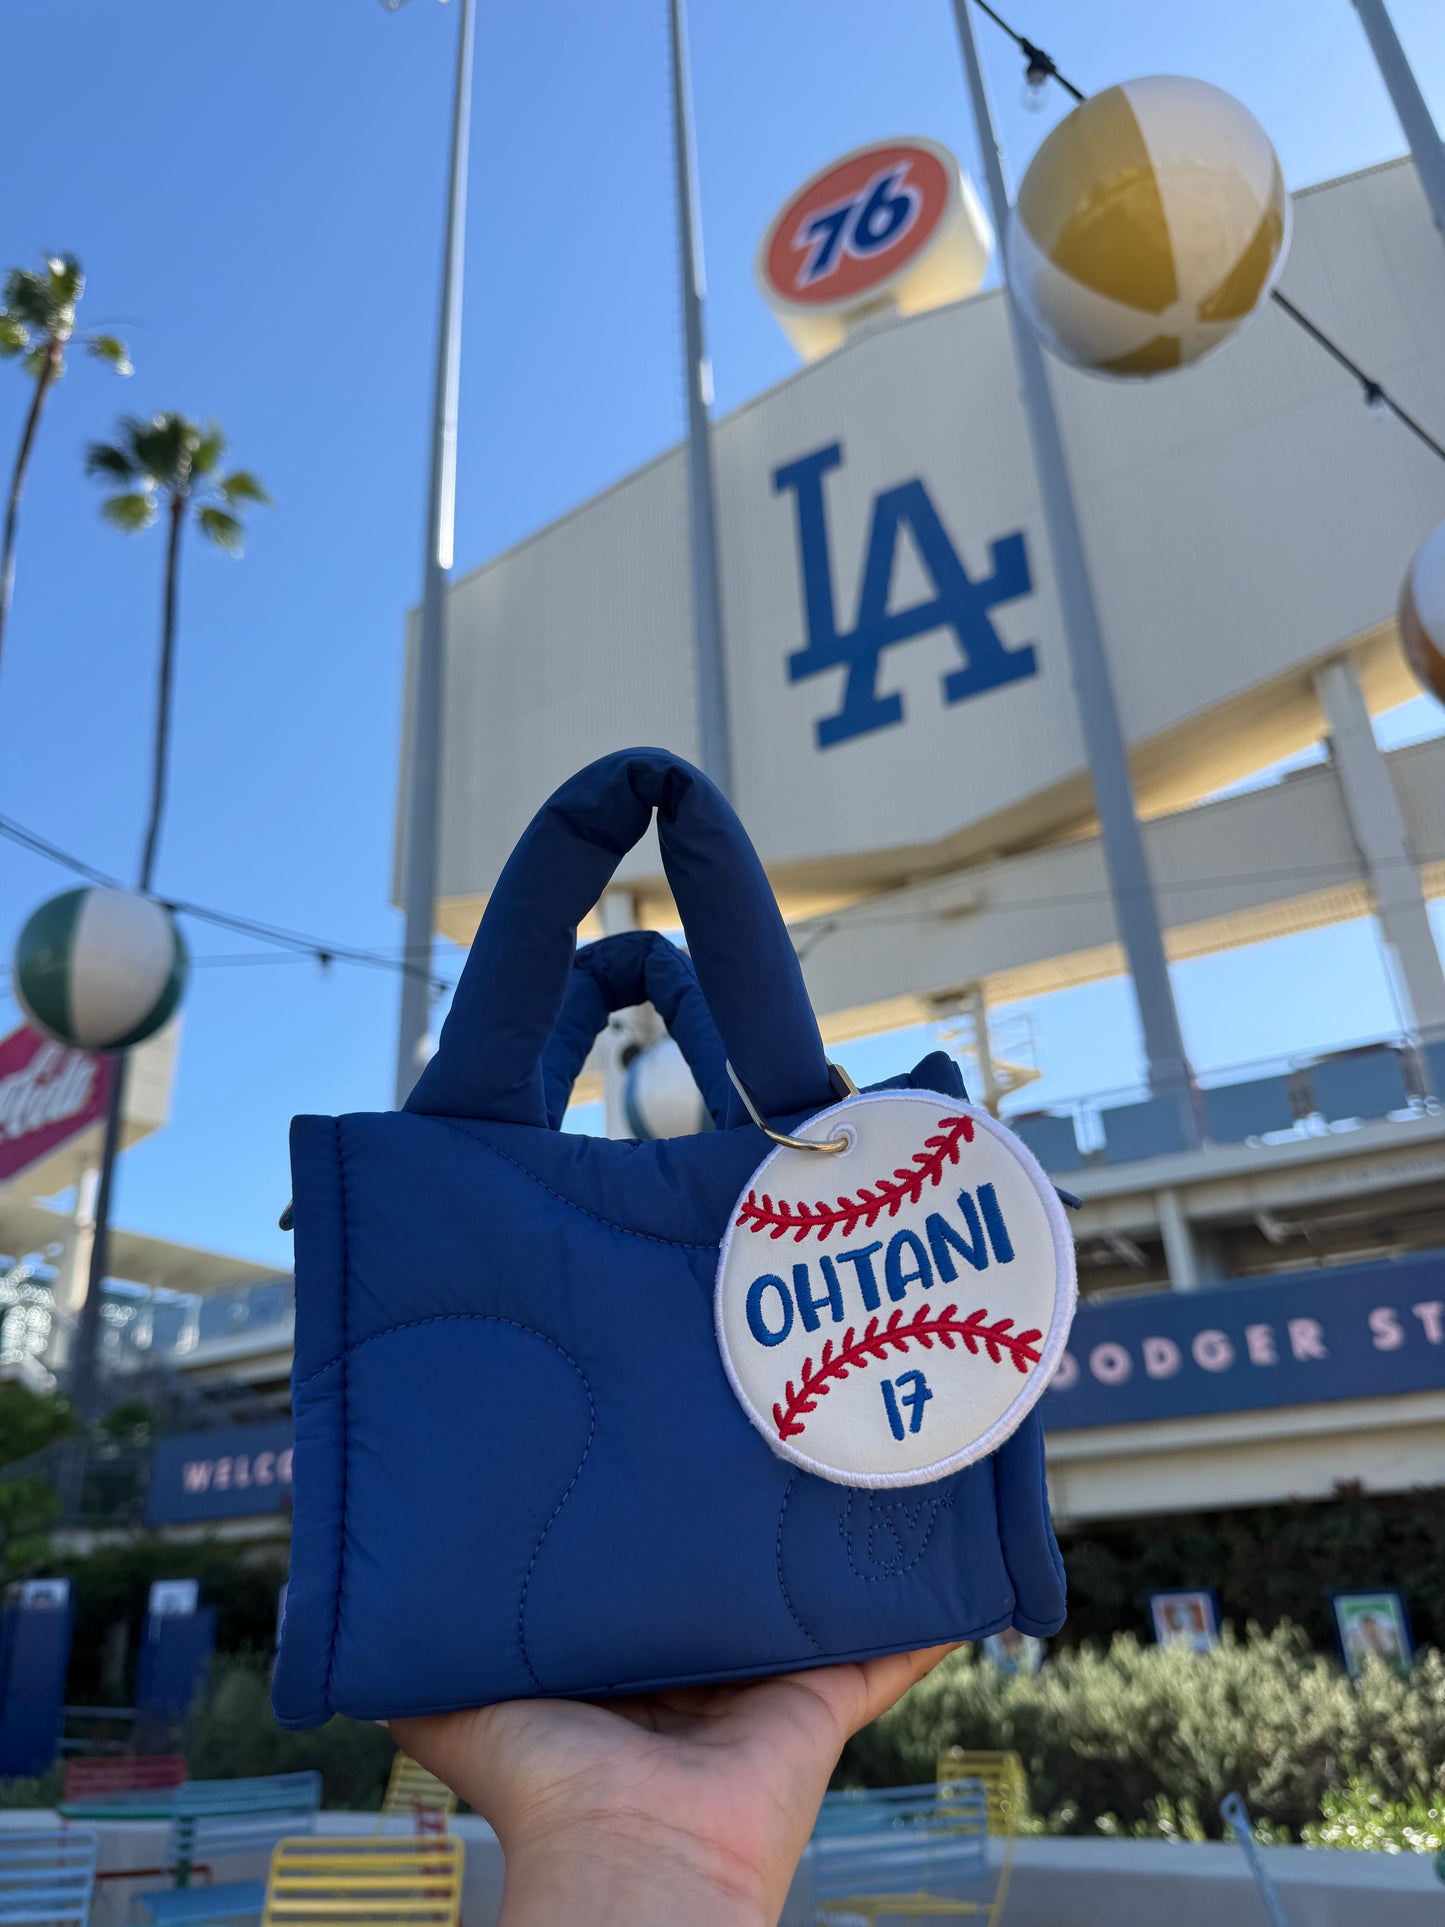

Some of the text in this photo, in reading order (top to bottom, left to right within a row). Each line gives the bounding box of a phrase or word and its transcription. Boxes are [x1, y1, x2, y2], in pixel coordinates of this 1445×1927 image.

[793, 160, 921, 288] 76
[774, 440, 1039, 750] LA
[745, 1182, 1015, 1347] OHTANI
[880, 1369, 933, 1441] 17
